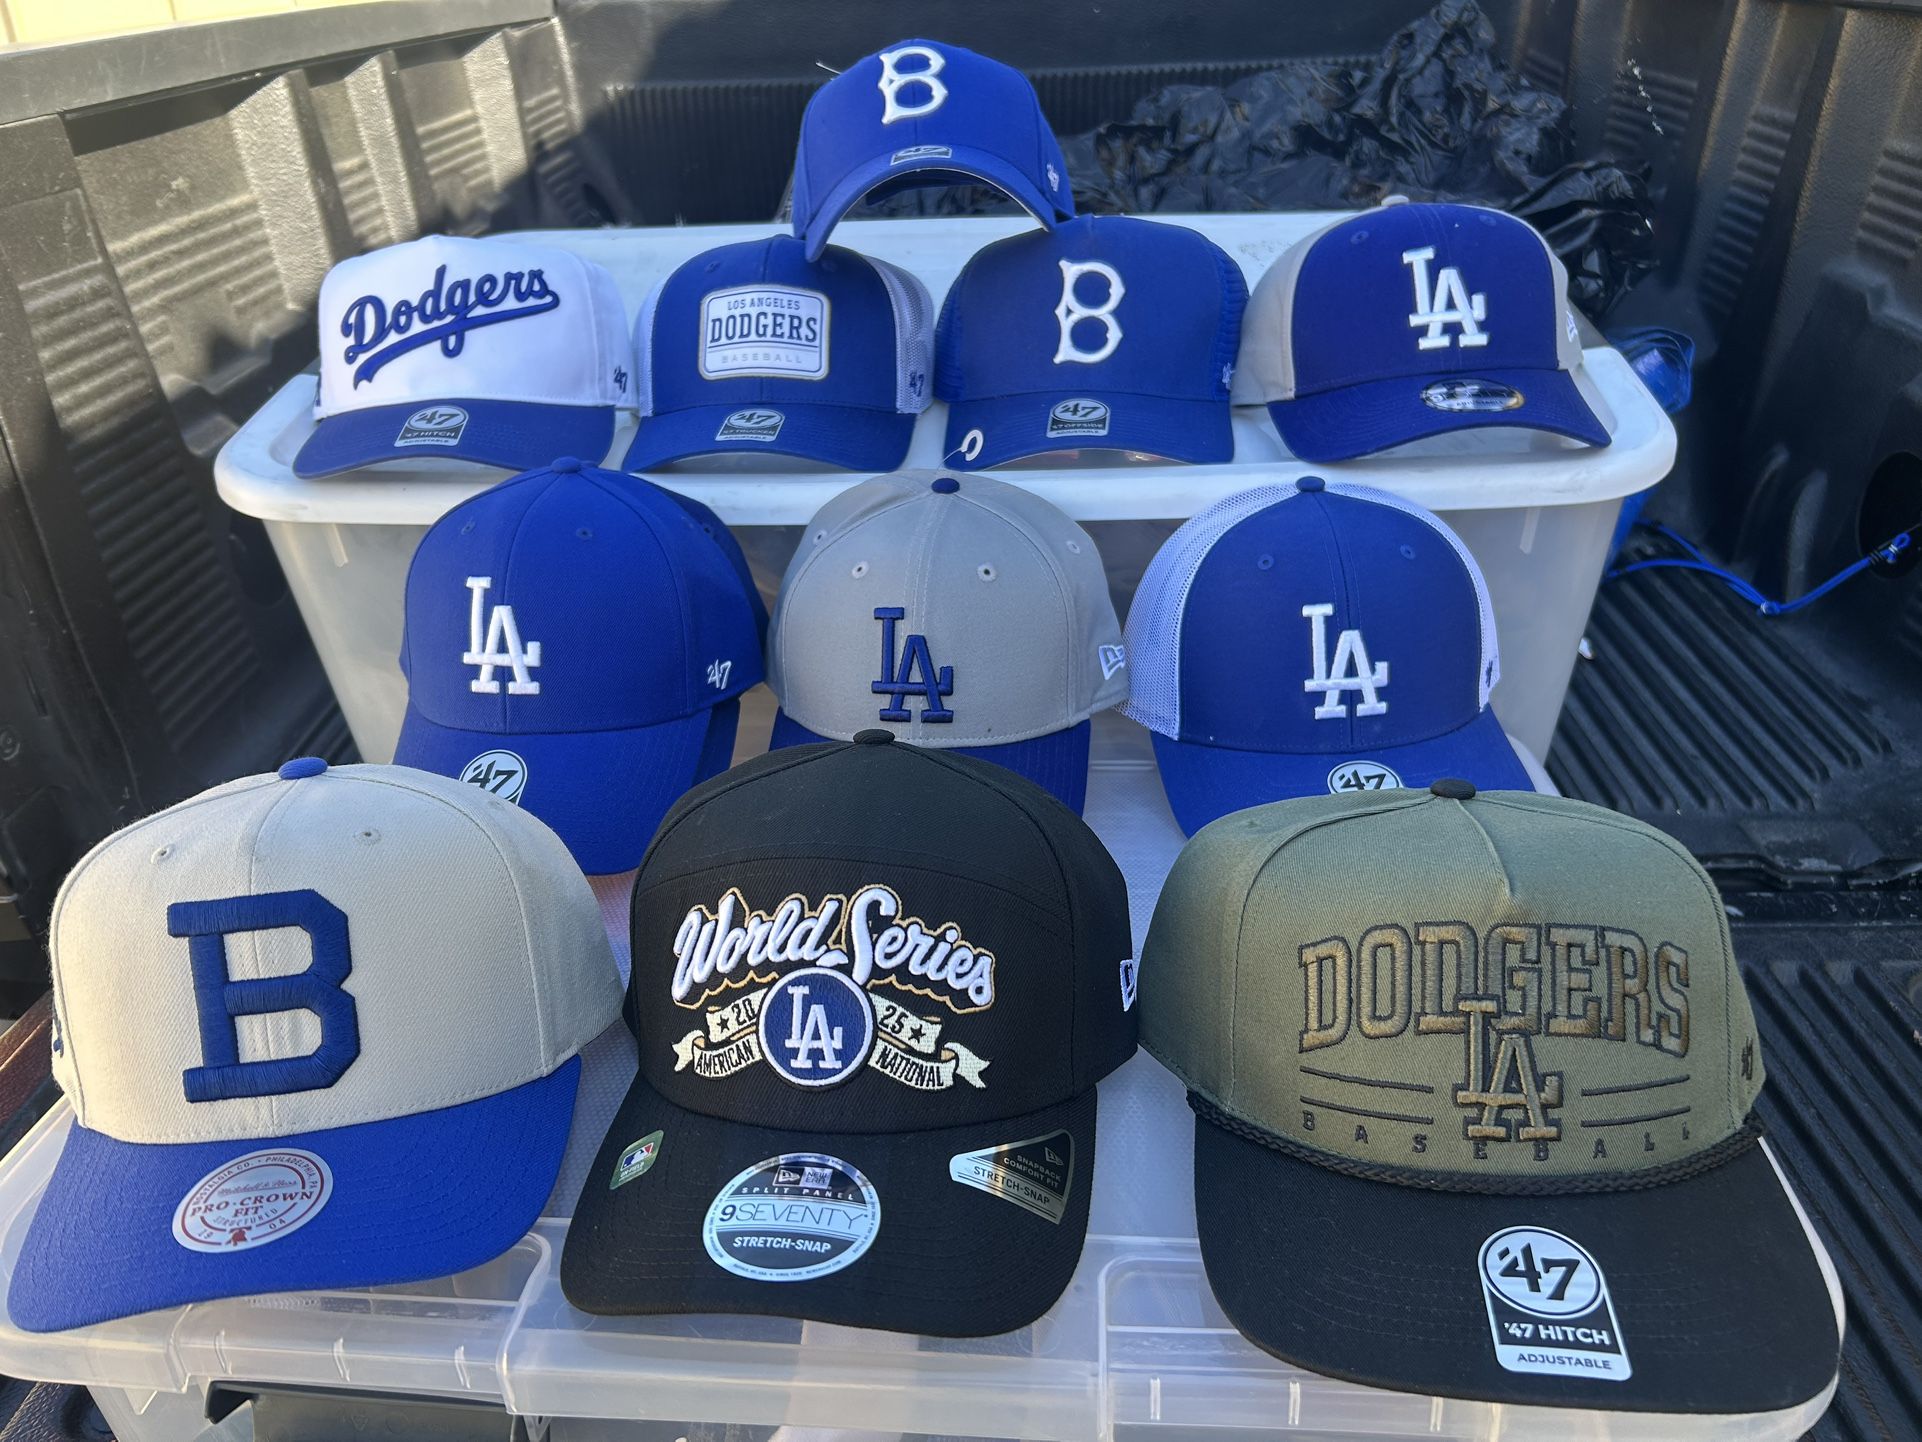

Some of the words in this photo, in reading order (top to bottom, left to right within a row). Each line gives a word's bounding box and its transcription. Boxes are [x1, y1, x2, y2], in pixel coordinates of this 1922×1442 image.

[878, 45, 949, 125] B
[341, 264, 555, 366] Dodgers
[727, 299, 746, 311] LOS
[749, 297, 801, 311] ANGELES
[1053, 258, 1126, 365] B
[1402, 245, 1490, 351] LA
[709, 311, 818, 344] DODGERS
[721, 352, 803, 364] BASEBALL
[463, 576, 541, 695] LA
[871, 607, 954, 723] LA
[1300, 603, 1389, 720] LA
[671, 893, 840, 1001] World
[818, 887, 993, 1006] Series
[167, 889, 361, 1103] B
[1298, 921, 1690, 1058] DODGERS
[734, 997, 756, 1026] 20
[878, 1004, 906, 1034] 25
[785, 985, 843, 1069] LA
[695, 1038, 755, 1075] AMERICAN
[876, 1045, 945, 1088] NATIONAL
[1452, 993, 1564, 1142] LA
[1302, 1110, 1690, 1161] BASEBALL
[973, 1165, 1051, 1206] STRETCH-SNAP
[1003, 1157, 1045, 1181] COMFORT
[1046, 1178, 1060, 1189] FIT
[1016, 1154, 1062, 1181] SNAPBACK
[232, 1205, 263, 1218] FIT
[741, 1187, 790, 1195] SPLIT
[802, 1188, 854, 1201] PANEL
[719, 1202, 864, 1230] 9SEVENTY
[733, 1236, 832, 1253] STRETCH-SNAP
[1538, 1324, 1612, 1346] HITCH
[1517, 1353, 1612, 1371] ADJUSTABLE
